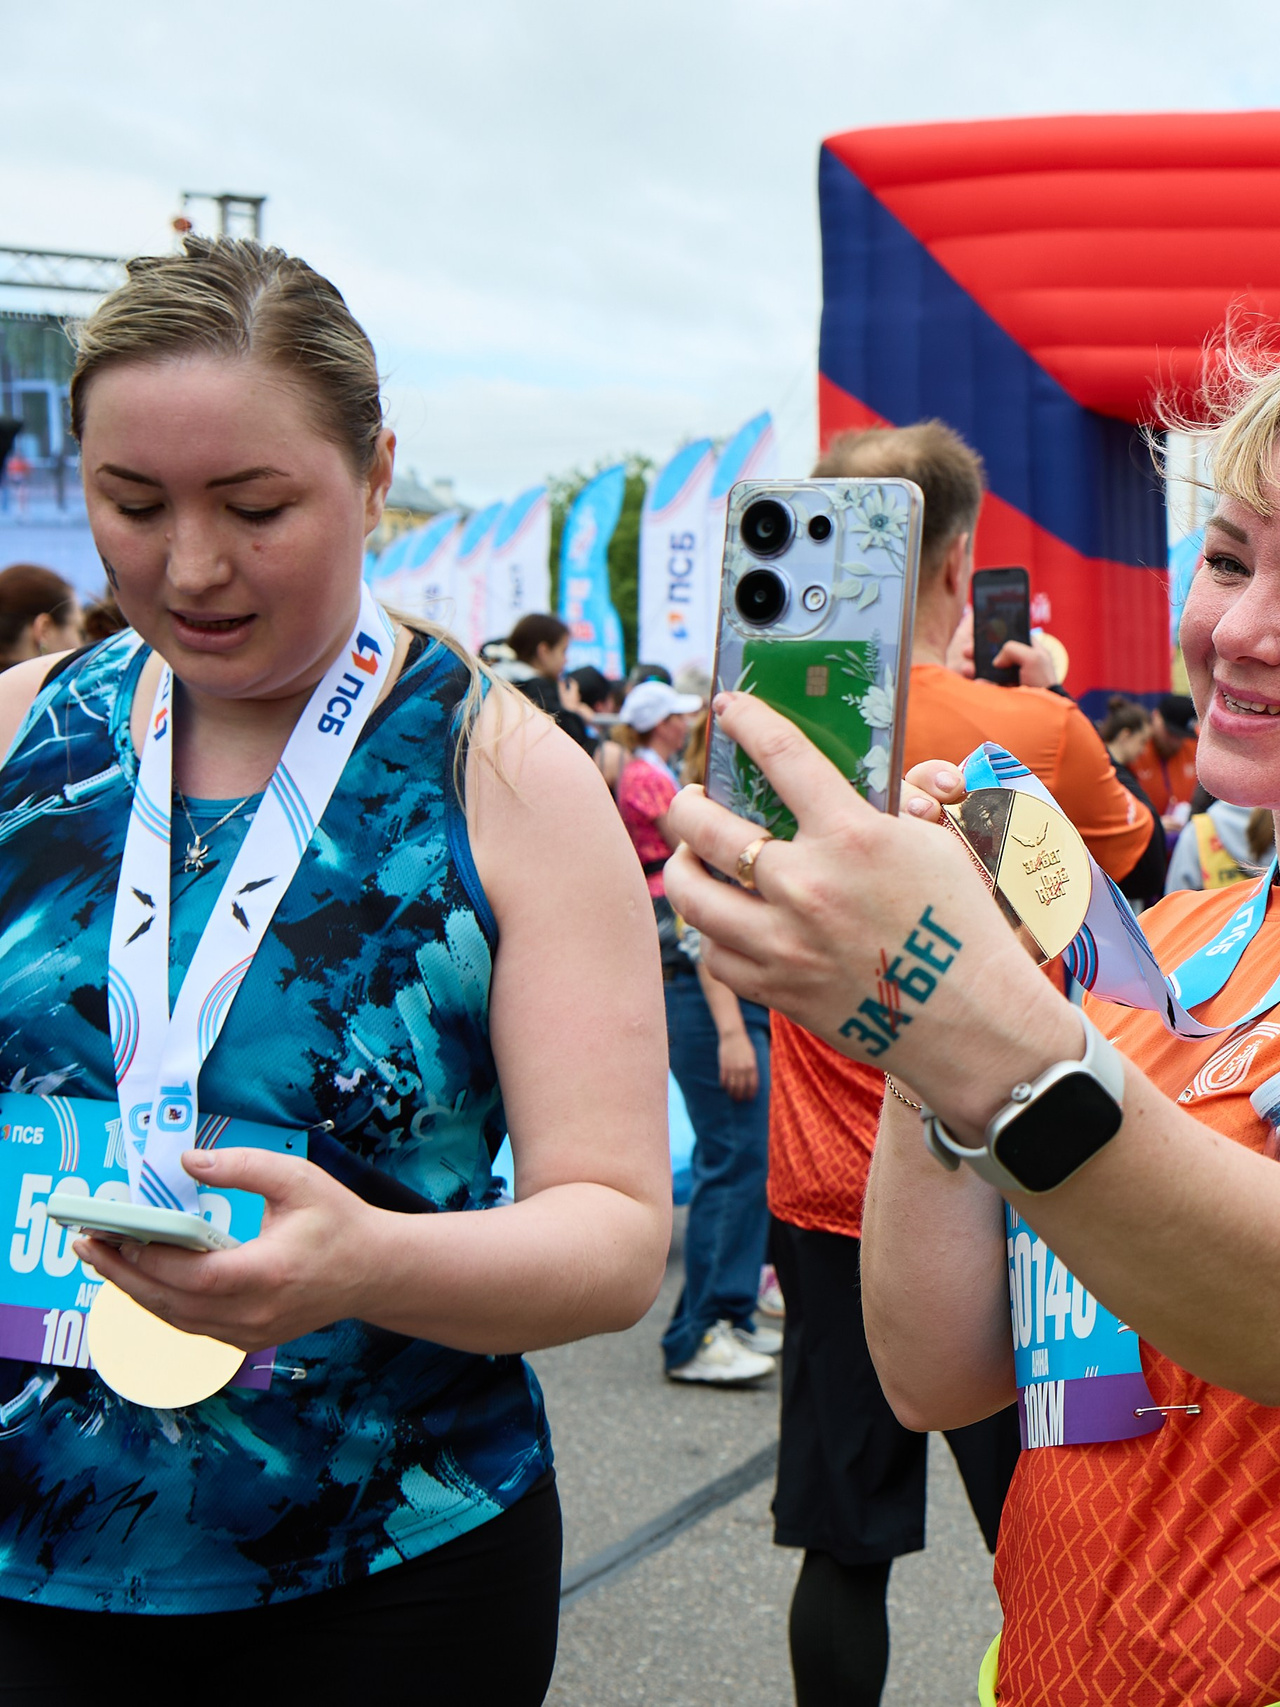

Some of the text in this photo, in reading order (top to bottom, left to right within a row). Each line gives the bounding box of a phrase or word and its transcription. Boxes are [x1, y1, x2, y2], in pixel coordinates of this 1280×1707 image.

[668, 531, 695, 605] ПСБ
[317, 672, 365, 737] ПСБ
[1205, 905, 1254, 957] ПСБ
[156, 1081, 193, 1133] 10
[12, 1125, 45, 1145] ПСБ
